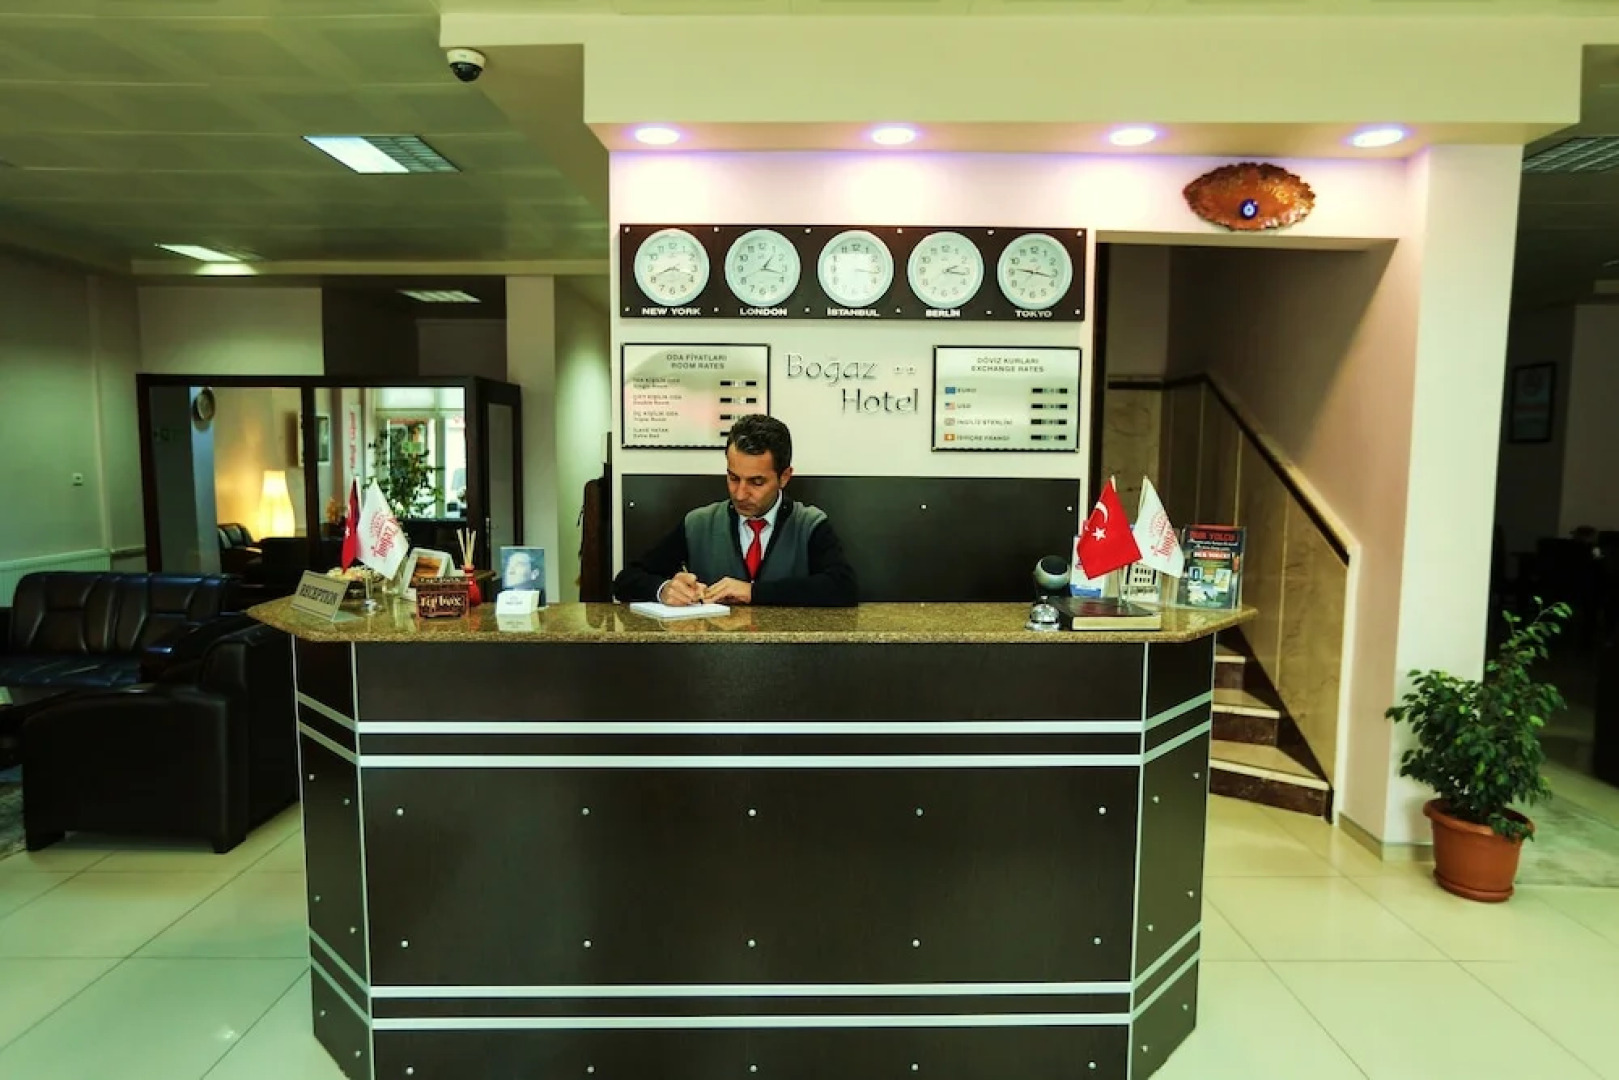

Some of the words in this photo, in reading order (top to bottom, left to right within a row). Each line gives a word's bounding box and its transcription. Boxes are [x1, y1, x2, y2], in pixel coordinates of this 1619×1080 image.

[740, 308, 787, 316] LONDON
[827, 307, 880, 316] İSTANBUL
[786, 353, 878, 387] Boğaz
[842, 388, 918, 414] Hotel
[300, 582, 339, 605] RECEPTION
